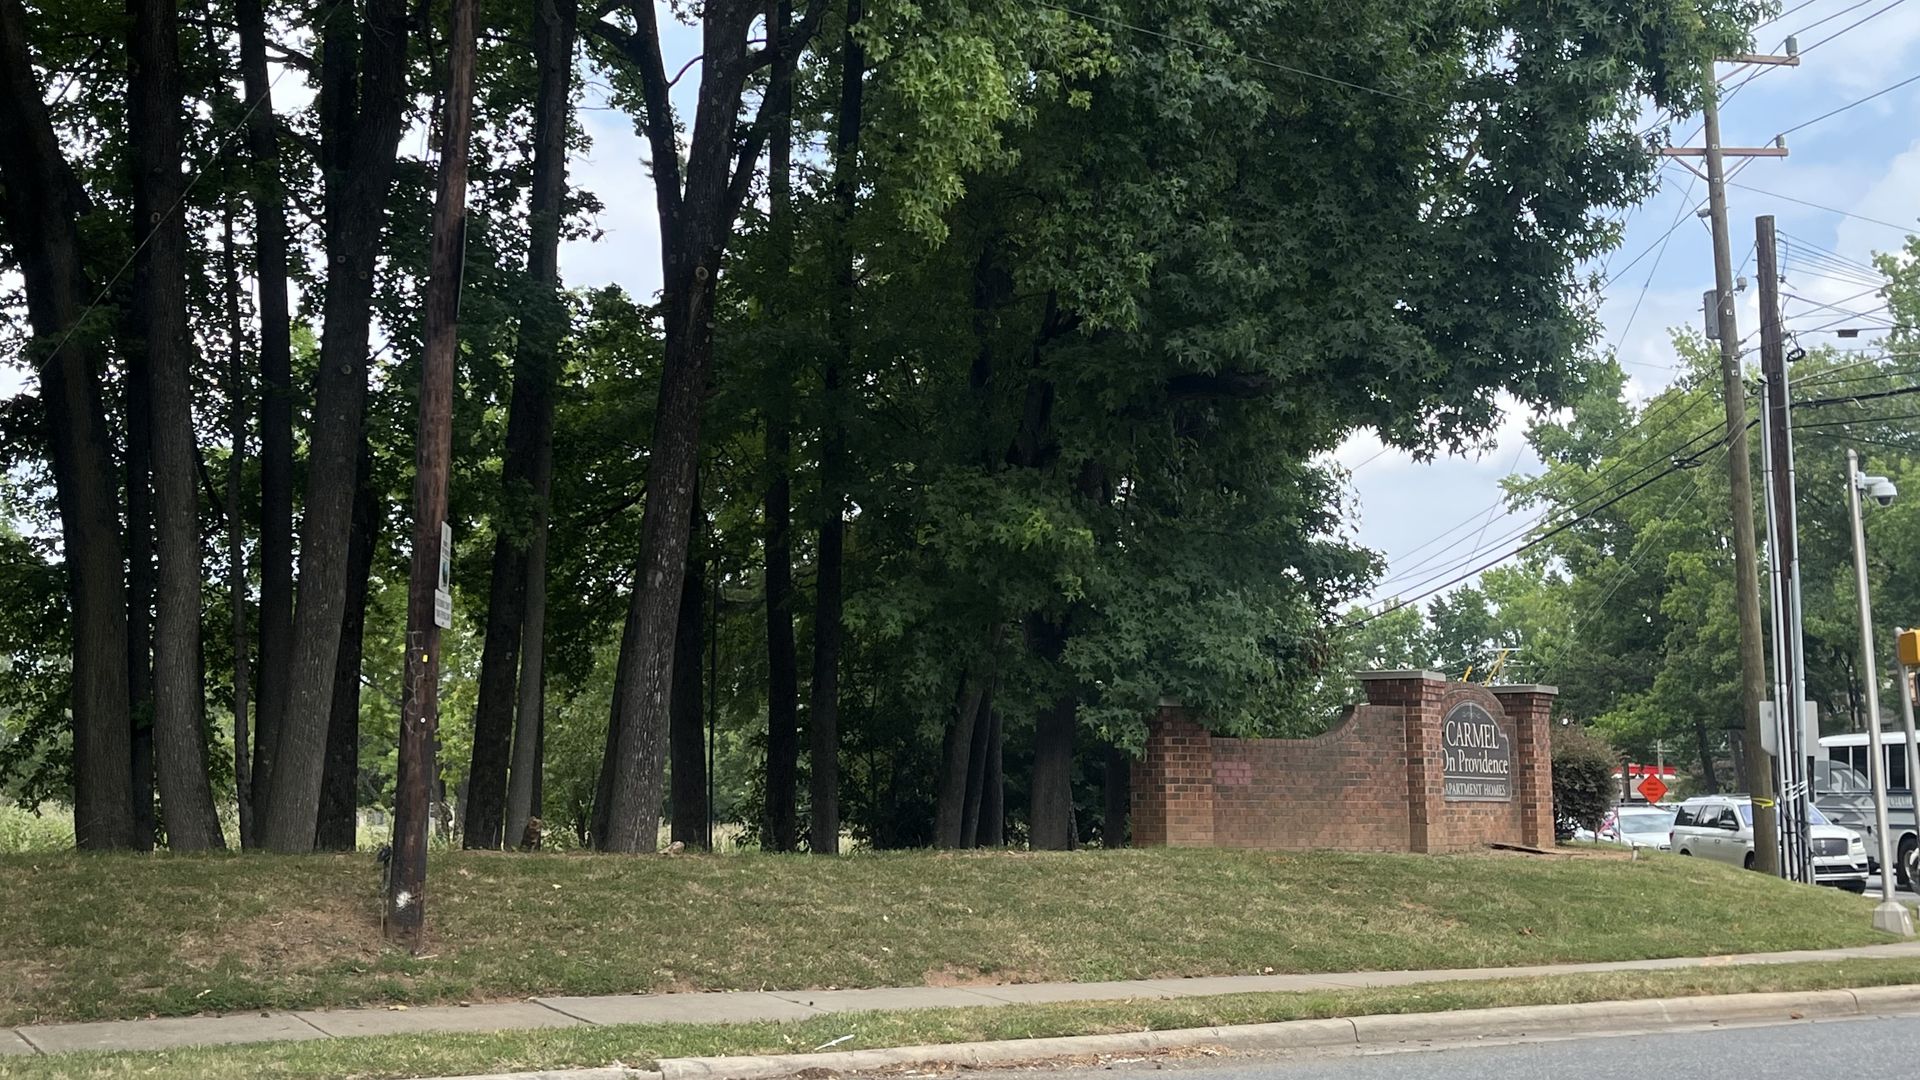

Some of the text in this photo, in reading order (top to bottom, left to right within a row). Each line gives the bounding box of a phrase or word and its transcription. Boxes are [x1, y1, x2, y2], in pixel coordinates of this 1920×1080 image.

[1446, 720, 1500, 749] CARMEL
[1457, 749, 1509, 775] Providence
[1445, 783, 1506, 796] APARTMENT HOMES
